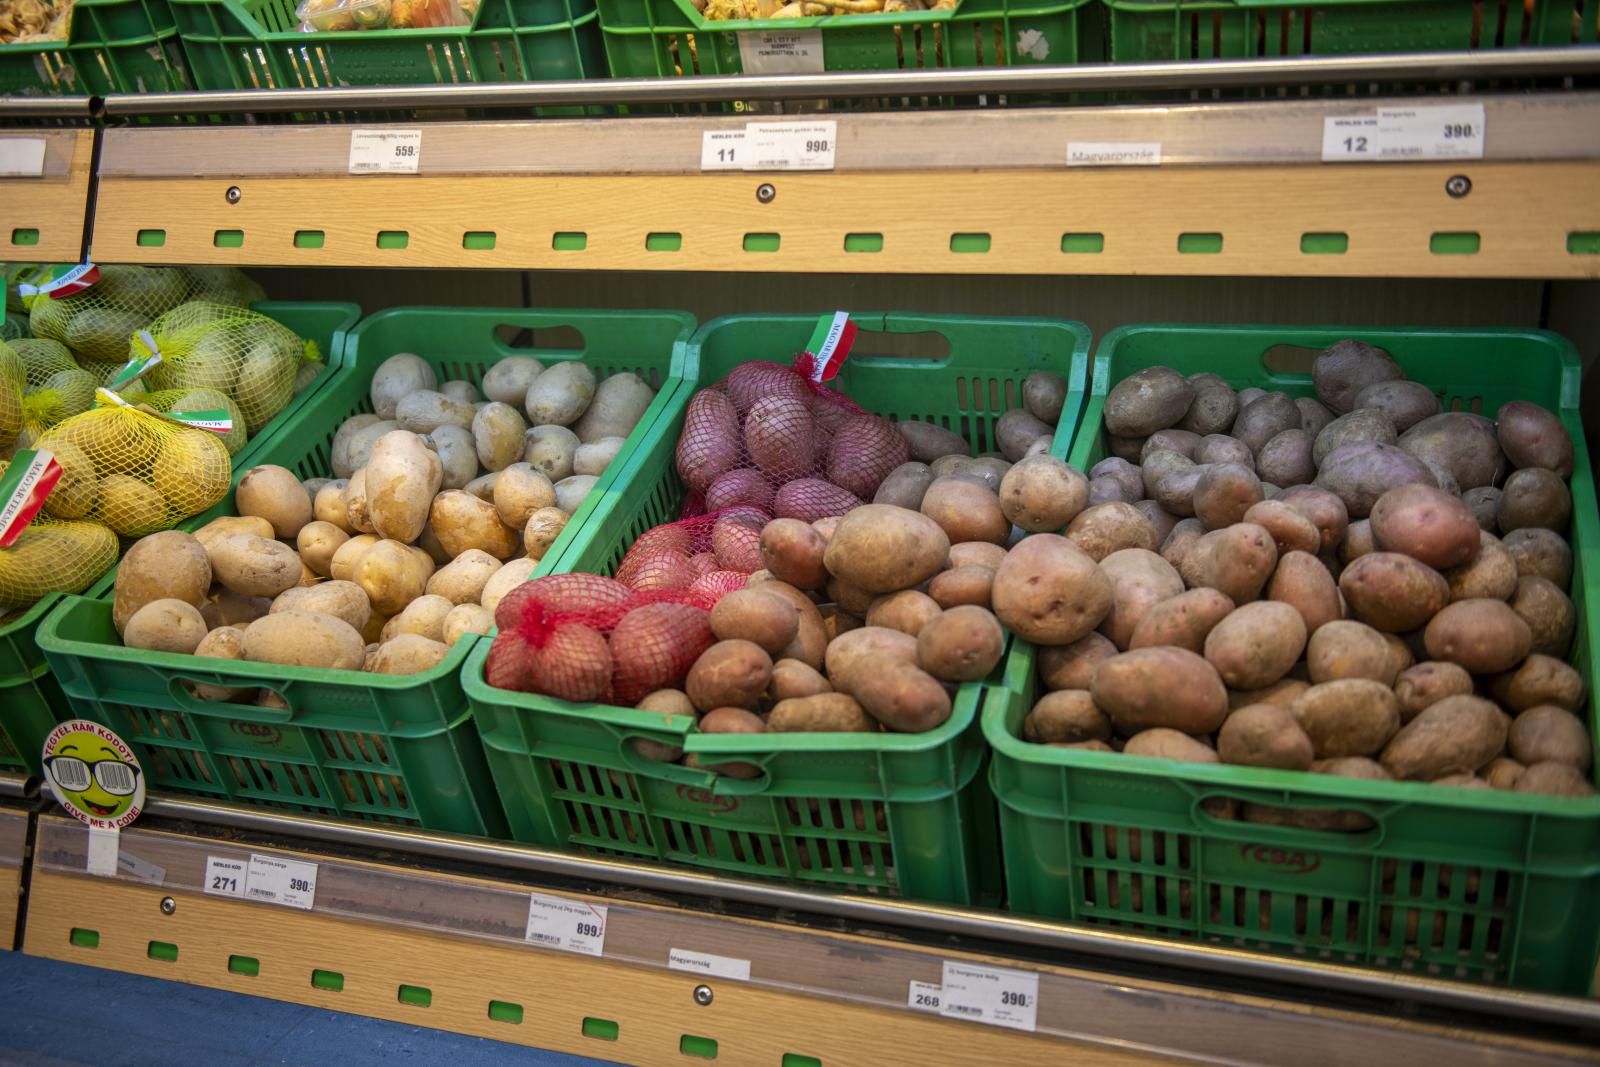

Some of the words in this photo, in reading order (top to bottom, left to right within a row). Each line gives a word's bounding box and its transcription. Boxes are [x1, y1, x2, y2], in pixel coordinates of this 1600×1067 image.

[1343, 137, 1368, 152] 12
[717, 148, 735, 162] 11
[45, 726, 71, 755] TEGYEL
[72, 721, 95, 733] RÁM
[97, 728, 134, 762] KÓDOT!
[63, 801, 87, 821] GIVE
[90, 818, 105, 828] ME
[108, 820, 115, 829] A
[117, 806, 140, 827] CODE!
[1254, 847, 1305, 866] CBA
[212, 876, 237, 892] 271
[916, 994, 939, 1007] 268
